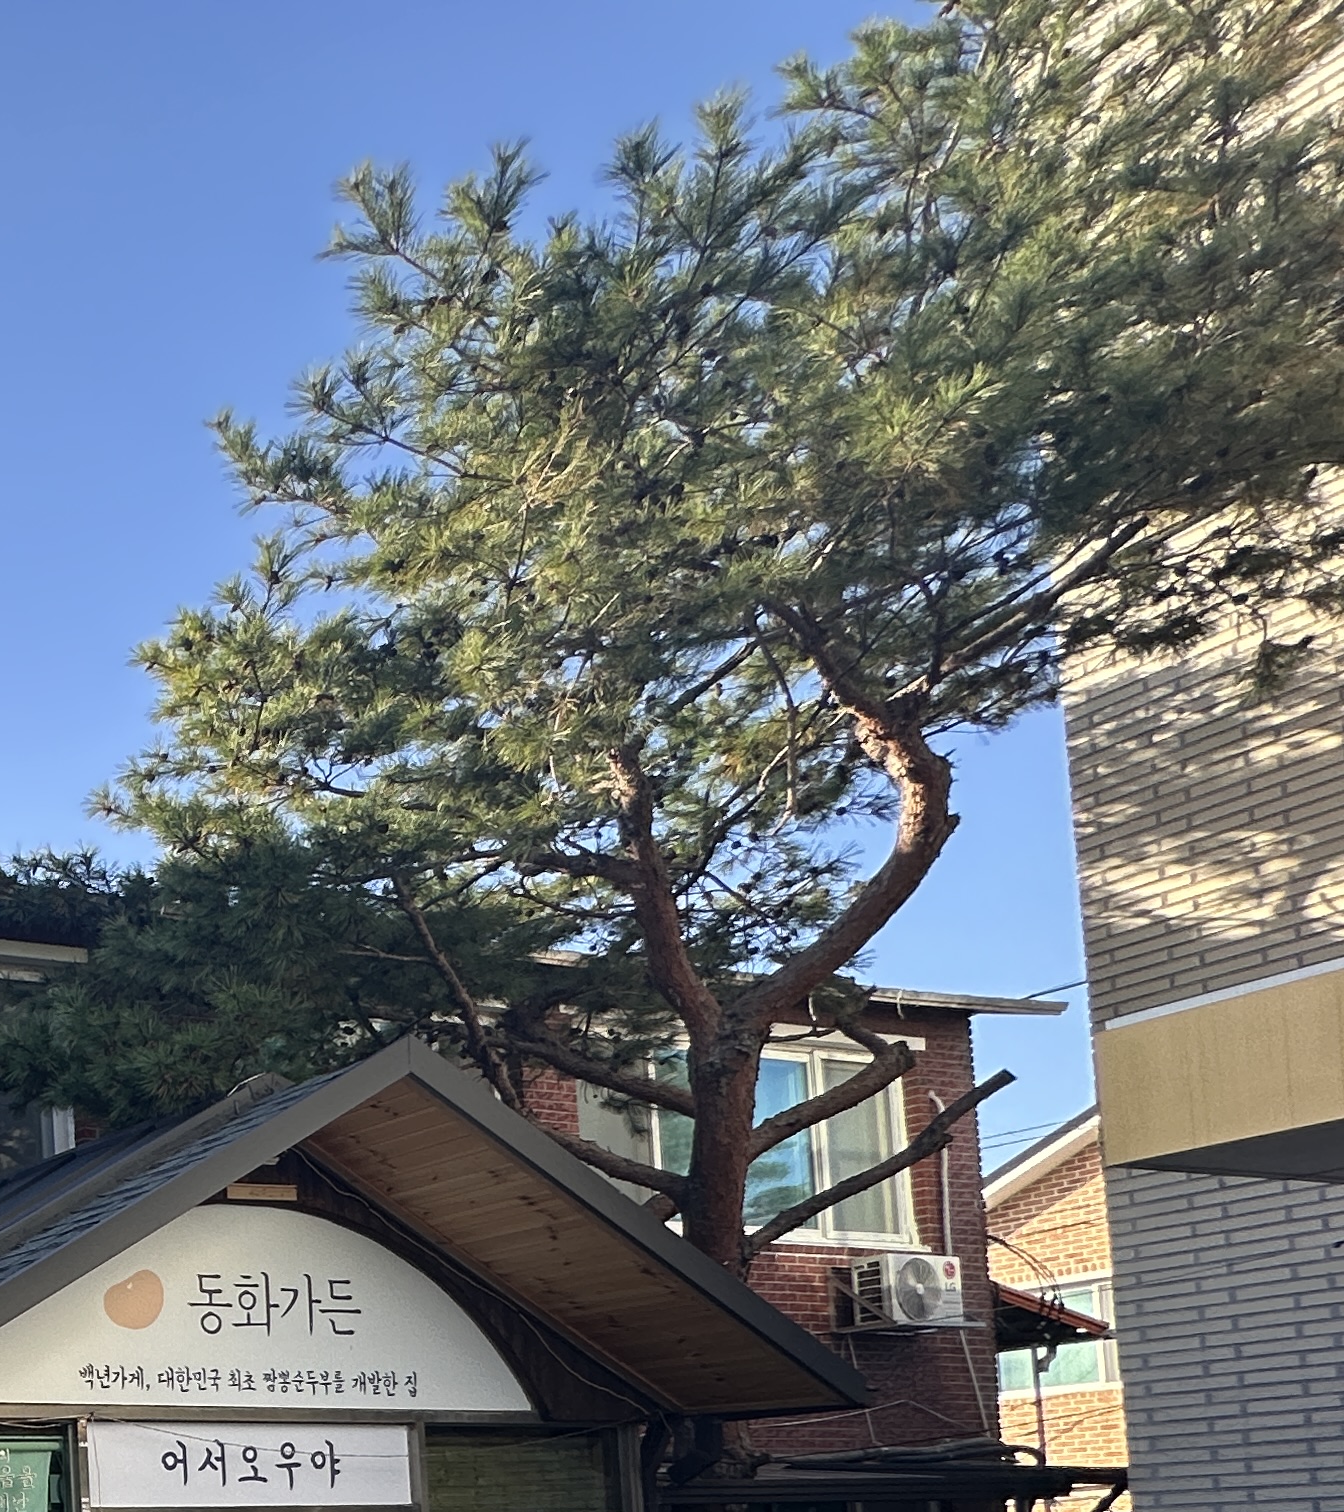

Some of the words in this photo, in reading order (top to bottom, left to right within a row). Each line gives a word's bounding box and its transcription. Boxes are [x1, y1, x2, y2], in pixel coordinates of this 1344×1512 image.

[187, 1272, 363, 1336] 동화가든
[944, 1281, 957, 1292] LG
[78, 1362, 151, 1391] 백년가게,
[157, 1366, 222, 1392] 대한민국
[226, 1371, 258, 1392] 최초
[262, 1371, 346, 1396] 짬뽕순두부를
[350, 1370, 399, 1398] 개발한
[403, 1371, 418, 1399] 집
[160, 1437, 342, 1490] 어서오우야
